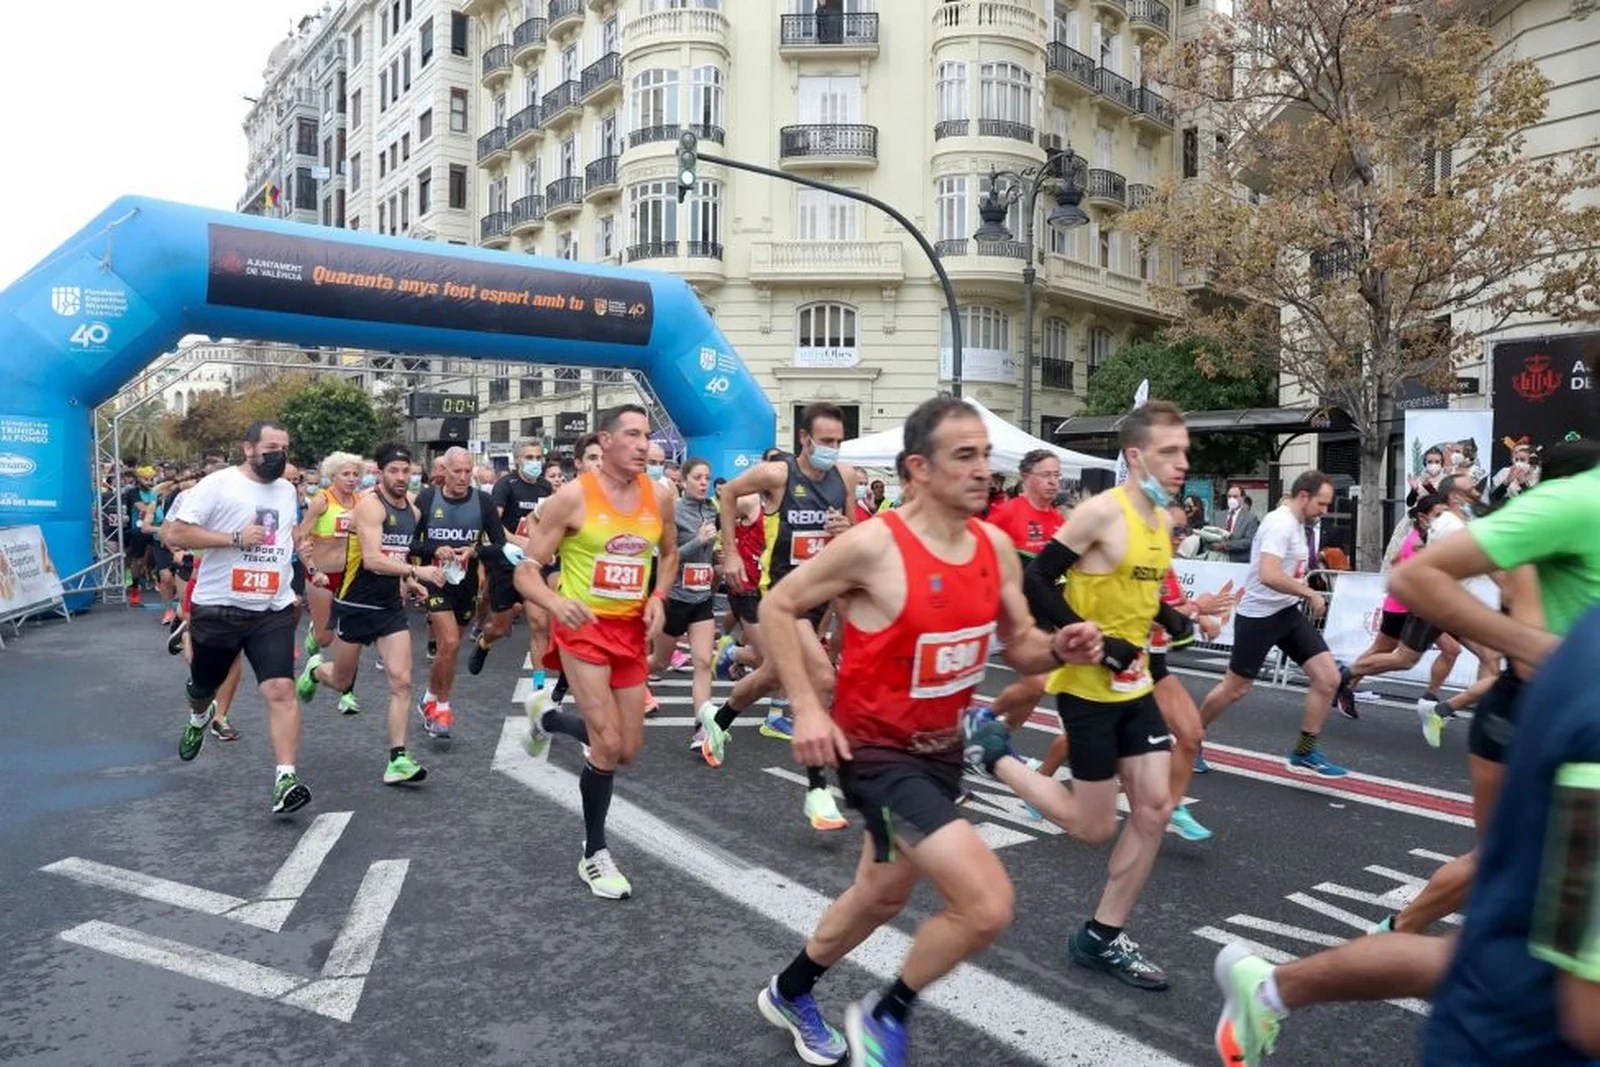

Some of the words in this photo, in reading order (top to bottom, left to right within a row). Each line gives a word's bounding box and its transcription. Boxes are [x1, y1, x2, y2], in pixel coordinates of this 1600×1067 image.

[246, 258, 303, 273] AJUNTAMENT
[312, 265, 394, 290] Quaranta
[397, 278, 439, 297] anys
[479, 287, 529, 306] esport
[532, 293, 566, 310] amb
[568, 294, 585, 311] tu
[69, 322, 112, 348] 40
[704, 376, 730, 395] 40
[427, 527, 481, 541] REDOLAT
[242, 571, 270, 588] 218
[603, 564, 639, 585] 1231
